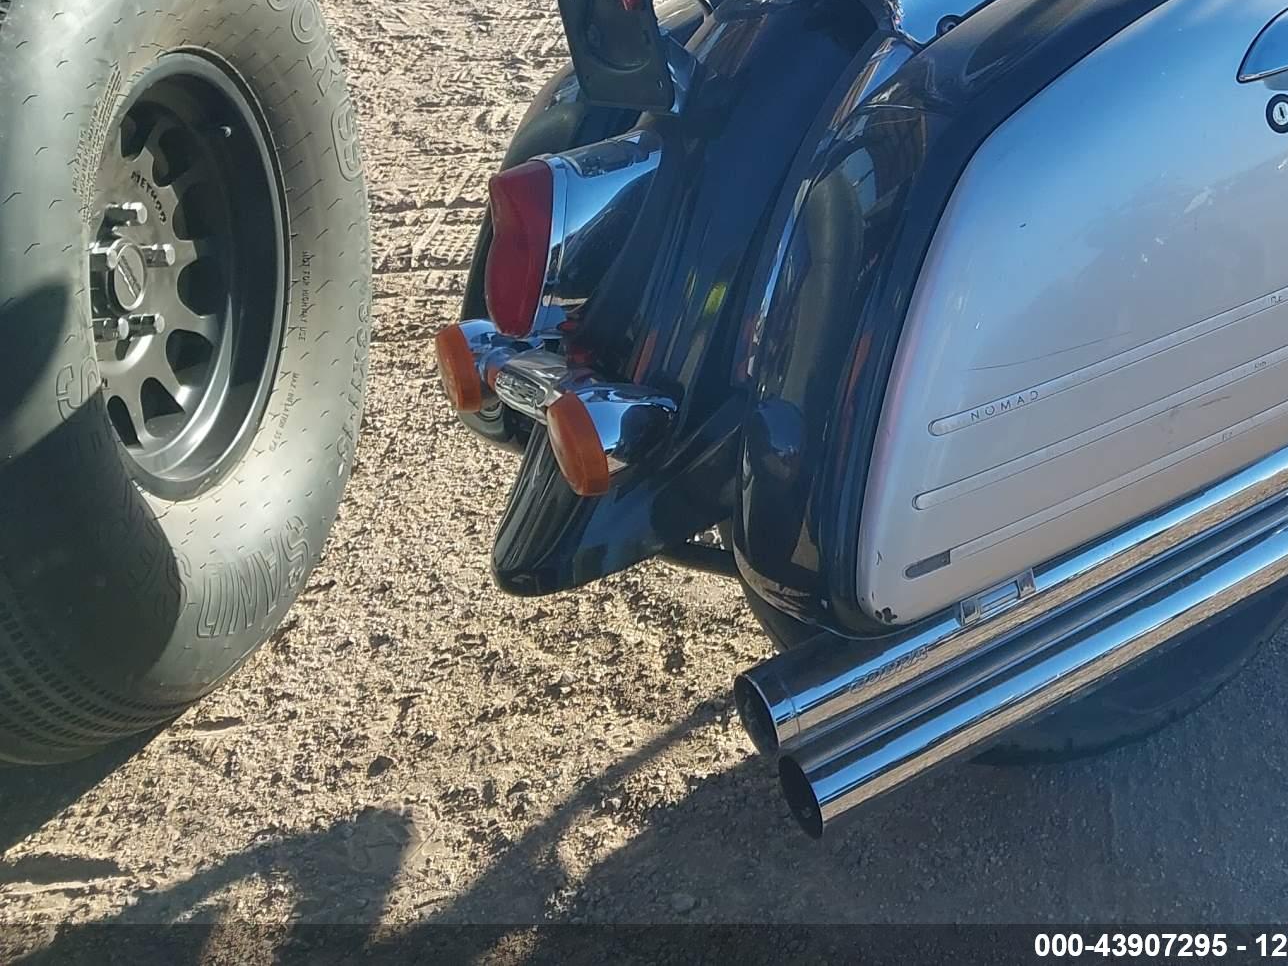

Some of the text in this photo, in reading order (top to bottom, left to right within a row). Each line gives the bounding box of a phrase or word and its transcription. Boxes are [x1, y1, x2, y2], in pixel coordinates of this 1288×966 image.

[130, 169, 167, 225] METHOD
[970, 390, 1040, 421] NOMAD
[196, 514, 309, 639] SAND
